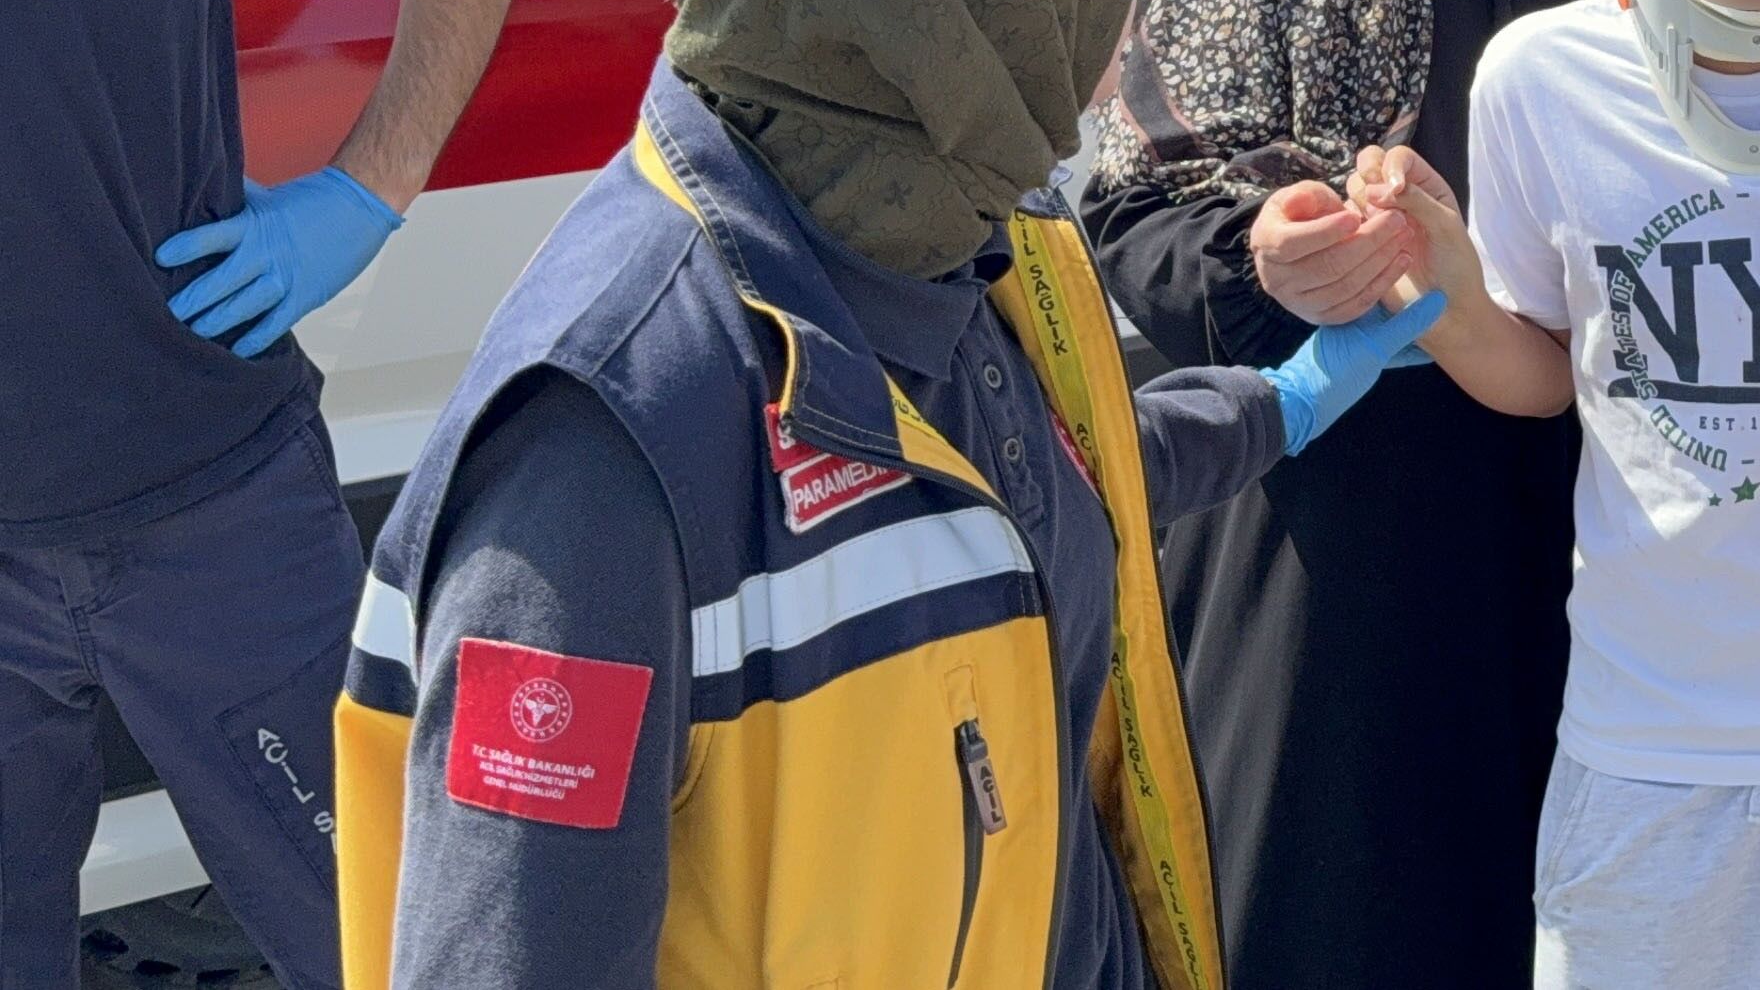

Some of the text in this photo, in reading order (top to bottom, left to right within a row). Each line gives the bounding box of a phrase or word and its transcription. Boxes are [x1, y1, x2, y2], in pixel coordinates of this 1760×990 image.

[1625, 189, 1725, 269] AMERICA
[1610, 269, 1659, 401] STATES OF
[1649, 404, 1728, 472] UNITED
[527, 758, 597, 779] BAKANLIĞI
